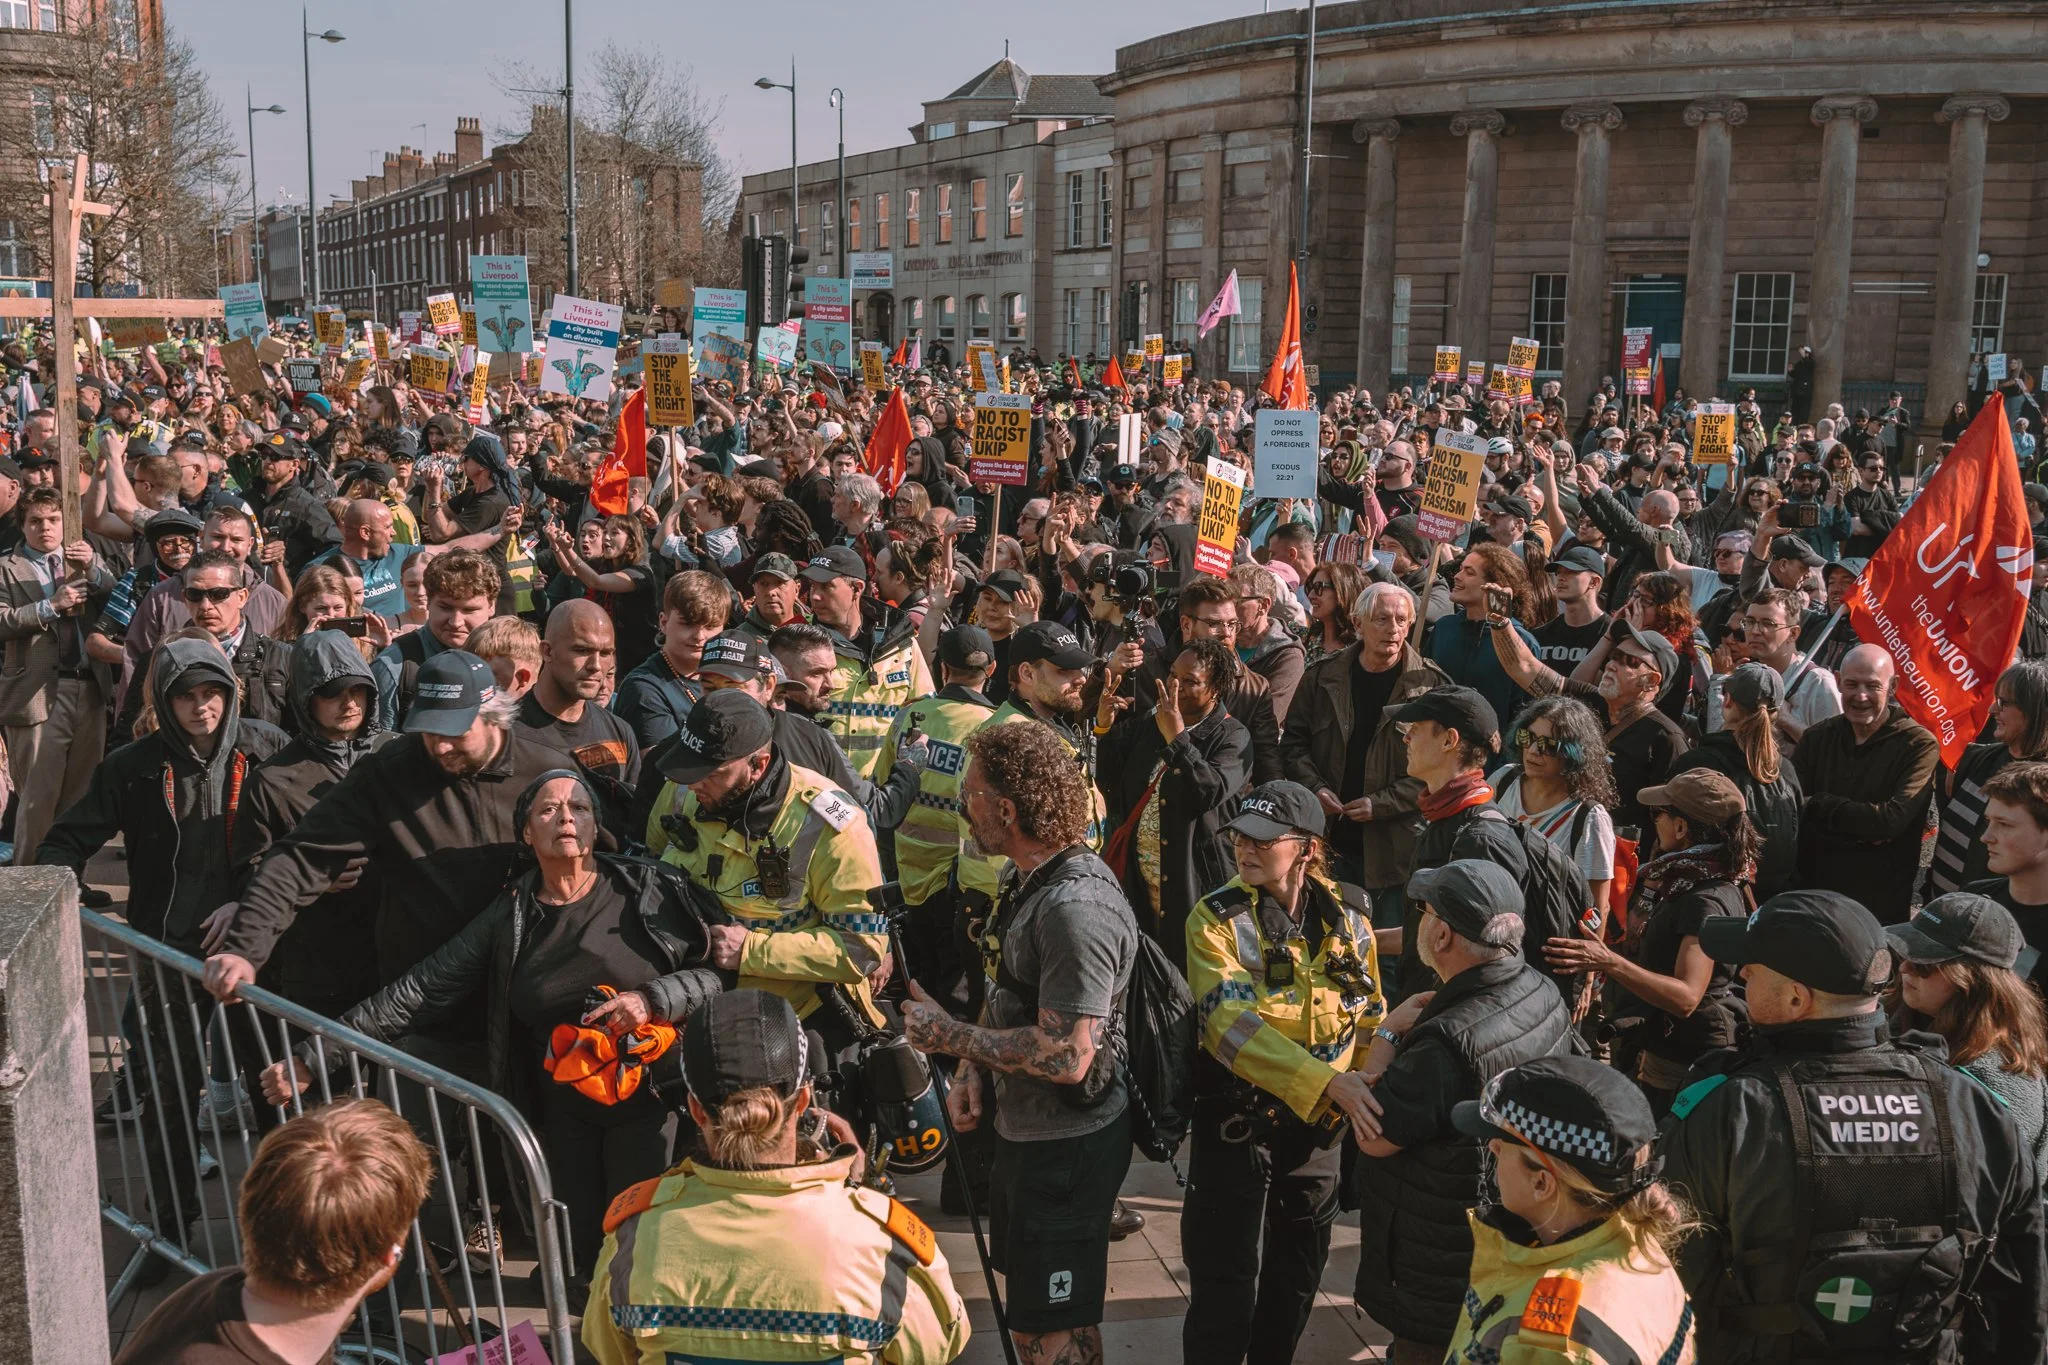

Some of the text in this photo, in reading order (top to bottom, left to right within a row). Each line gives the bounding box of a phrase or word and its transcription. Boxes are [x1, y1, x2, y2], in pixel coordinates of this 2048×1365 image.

[486, 262, 512, 270] This is
[481, 272, 519, 280] Liverpool
[817, 285, 831, 293] This
[812, 294, 842, 304] Liverpool
[432, 308, 456, 316] RACIST
[573, 304, 603, 317] This is
[434, 316, 450, 324] UKIP
[564, 313, 609, 328] Liverpool
[572, 326, 585, 336] city
[587, 328, 603, 336] built
[574, 333, 604, 345] diversity
[1512, 344, 1522, 352] NO
[651, 355, 678, 368] STOP
[714, 353, 731, 364] NOT
[864, 351, 876, 359] STOP
[1511, 352, 1535, 361] RACIST
[412, 356, 430, 368] NO TO
[290, 365, 315, 378] DUMP
[412, 366, 434, 378] RACIST
[652, 369, 671, 382] THE
[292, 378, 321, 392] TRUMP
[653, 383, 671, 396] FAR
[655, 396, 685, 411] RIGHT
[977, 410, 1019, 426] NO TO
[1702, 415, 1726, 424] STOP
[976, 426, 1026, 442] RACIST
[1702, 425, 1719, 434] THE
[1700, 435, 1718, 444] FAR
[974, 441, 1007, 457] UKIP
[1699, 444, 1728, 454] RIGHT
[1434, 449, 1461, 467] NO TO
[1431, 463, 1469, 487] RACISM,
[1206, 478, 1235, 505] NO TO
[1427, 478, 1455, 497] NO TO
[1424, 492, 1467, 516] FASCISM
[1204, 498, 1236, 526] RACIST
[1421, 512, 1456, 528] Unite against
[1202, 518, 1225, 541] UKIP
[1418, 522, 1428, 531] the
[1435, 526, 1450, 539] right
[363, 582, 397, 598] Columbia
[719, 638, 747, 650] BRITAIN
[1910, 594, 1980, 692] theUNION
[720, 651, 745, 663] AGAIN
[1856, 574, 1956, 746] www.unitetheunion.org
[888, 672, 910, 683] POLIC
[928, 740, 958, 773] ICE
[1240, 798, 1276, 815] POLICE
[1818, 1094, 1922, 1115] POLICE
[1830, 1121, 1920, 1142] MEDIC
